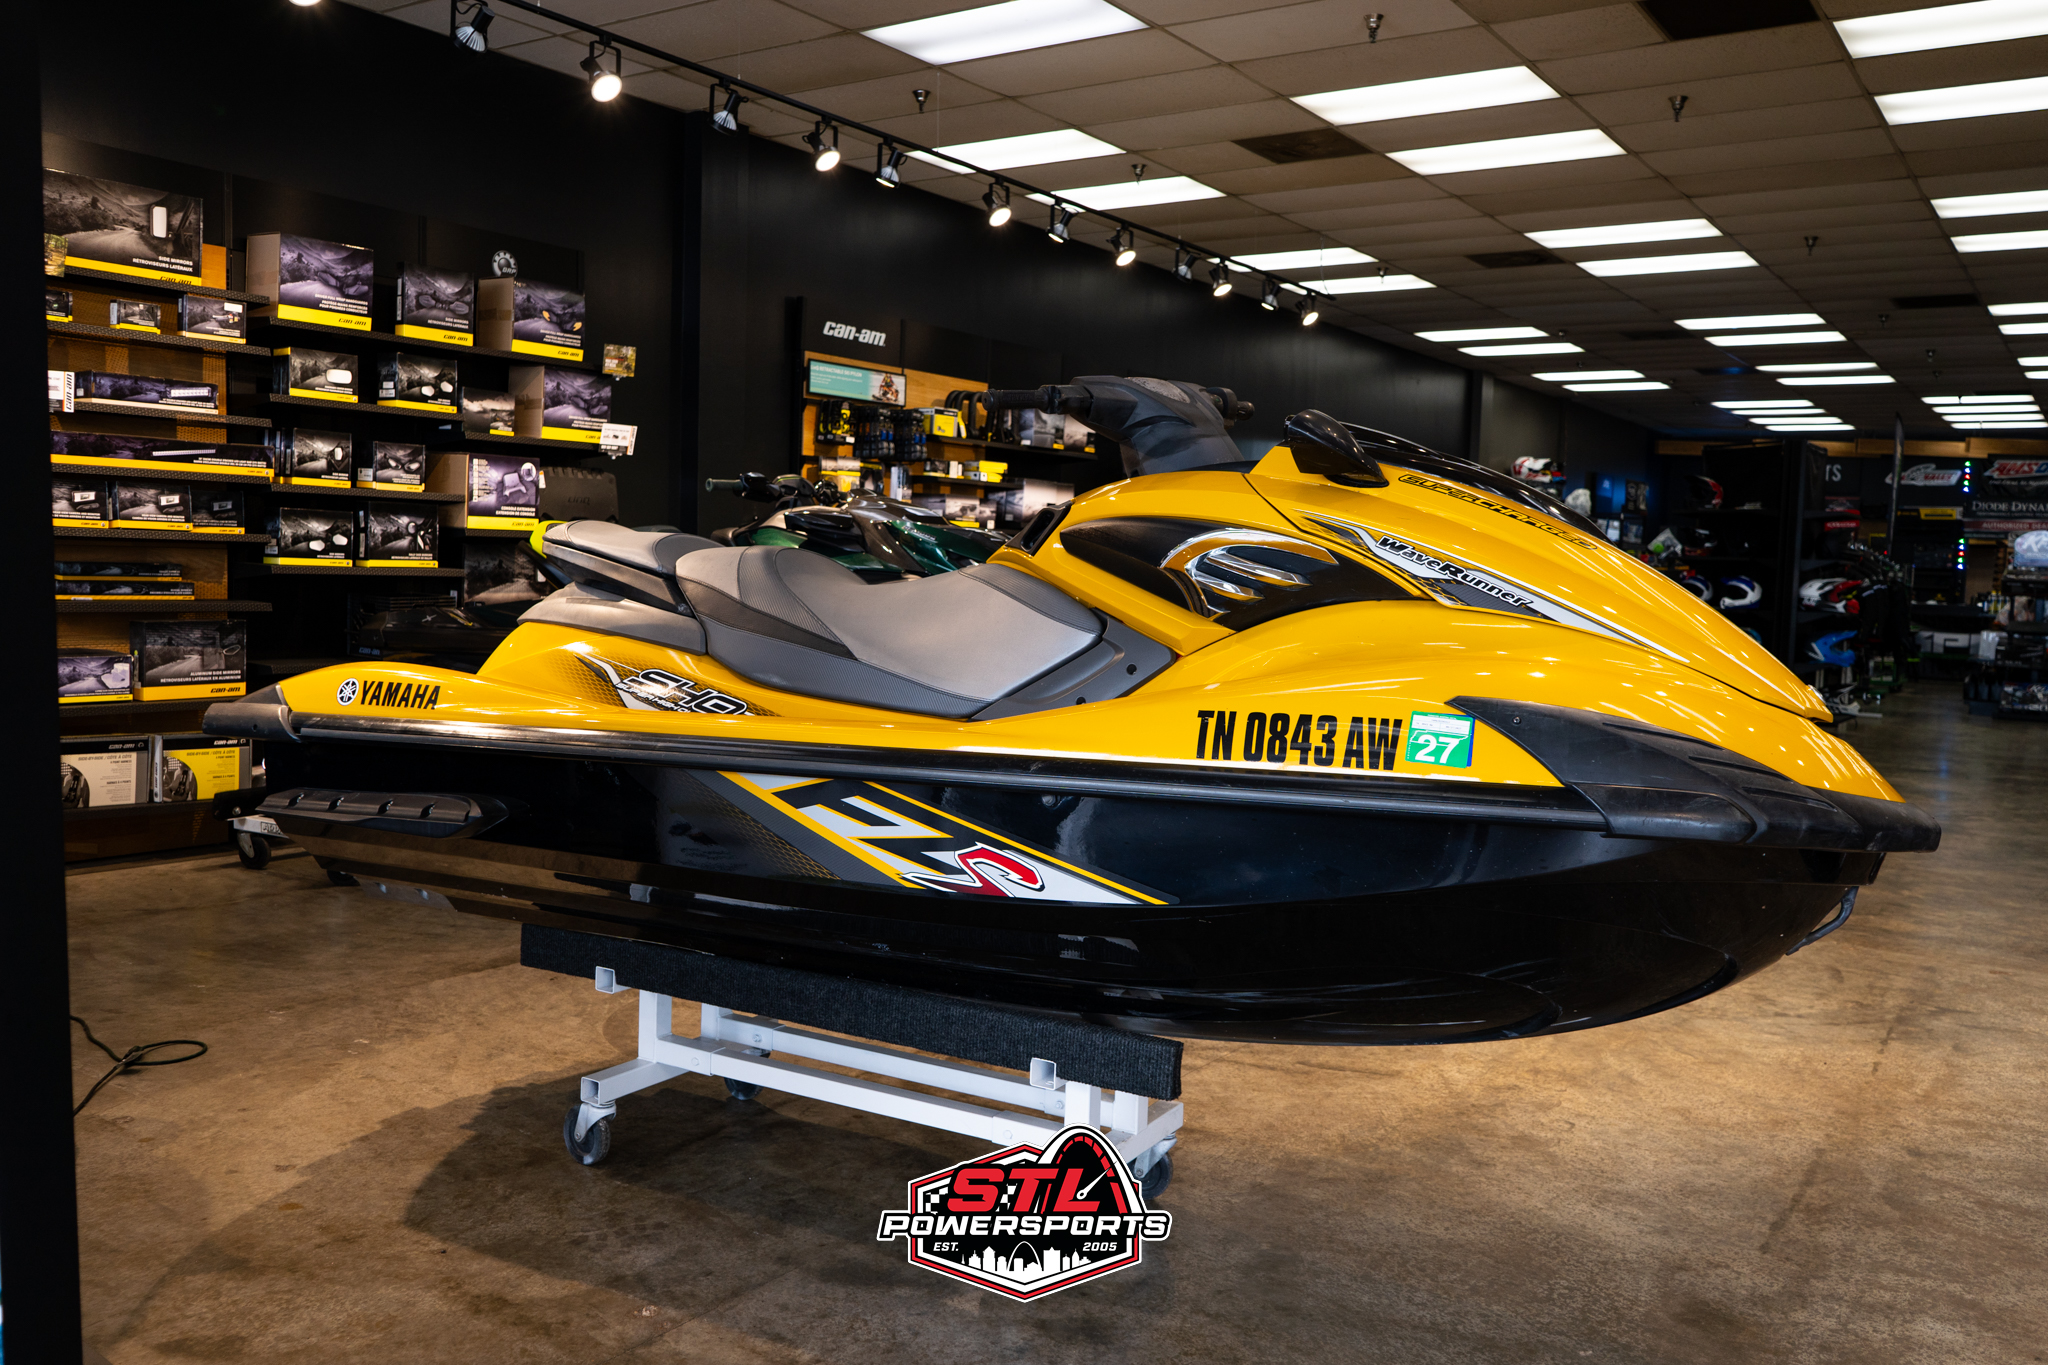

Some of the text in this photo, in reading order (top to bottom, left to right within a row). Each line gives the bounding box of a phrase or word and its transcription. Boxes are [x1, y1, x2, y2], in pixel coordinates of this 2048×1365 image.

[170, 257, 193, 266] MIRRORS
[822, 321, 887, 347] can-am
[1399, 474, 1598, 550] SUPERCHARGED
[1972, 501, 2009, 511] DIODE
[1982, 521, 2030, 530] AUTHORIZED
[1375, 534, 1534, 607] WaveRunner
[210, 686, 241, 694] can-am
[361, 680, 441, 710] YAMAHA
[622, 668, 748, 716] SHO
[1196, 709, 1403, 771] TN 0843 AW
[1414, 734, 1460, 764] 27
